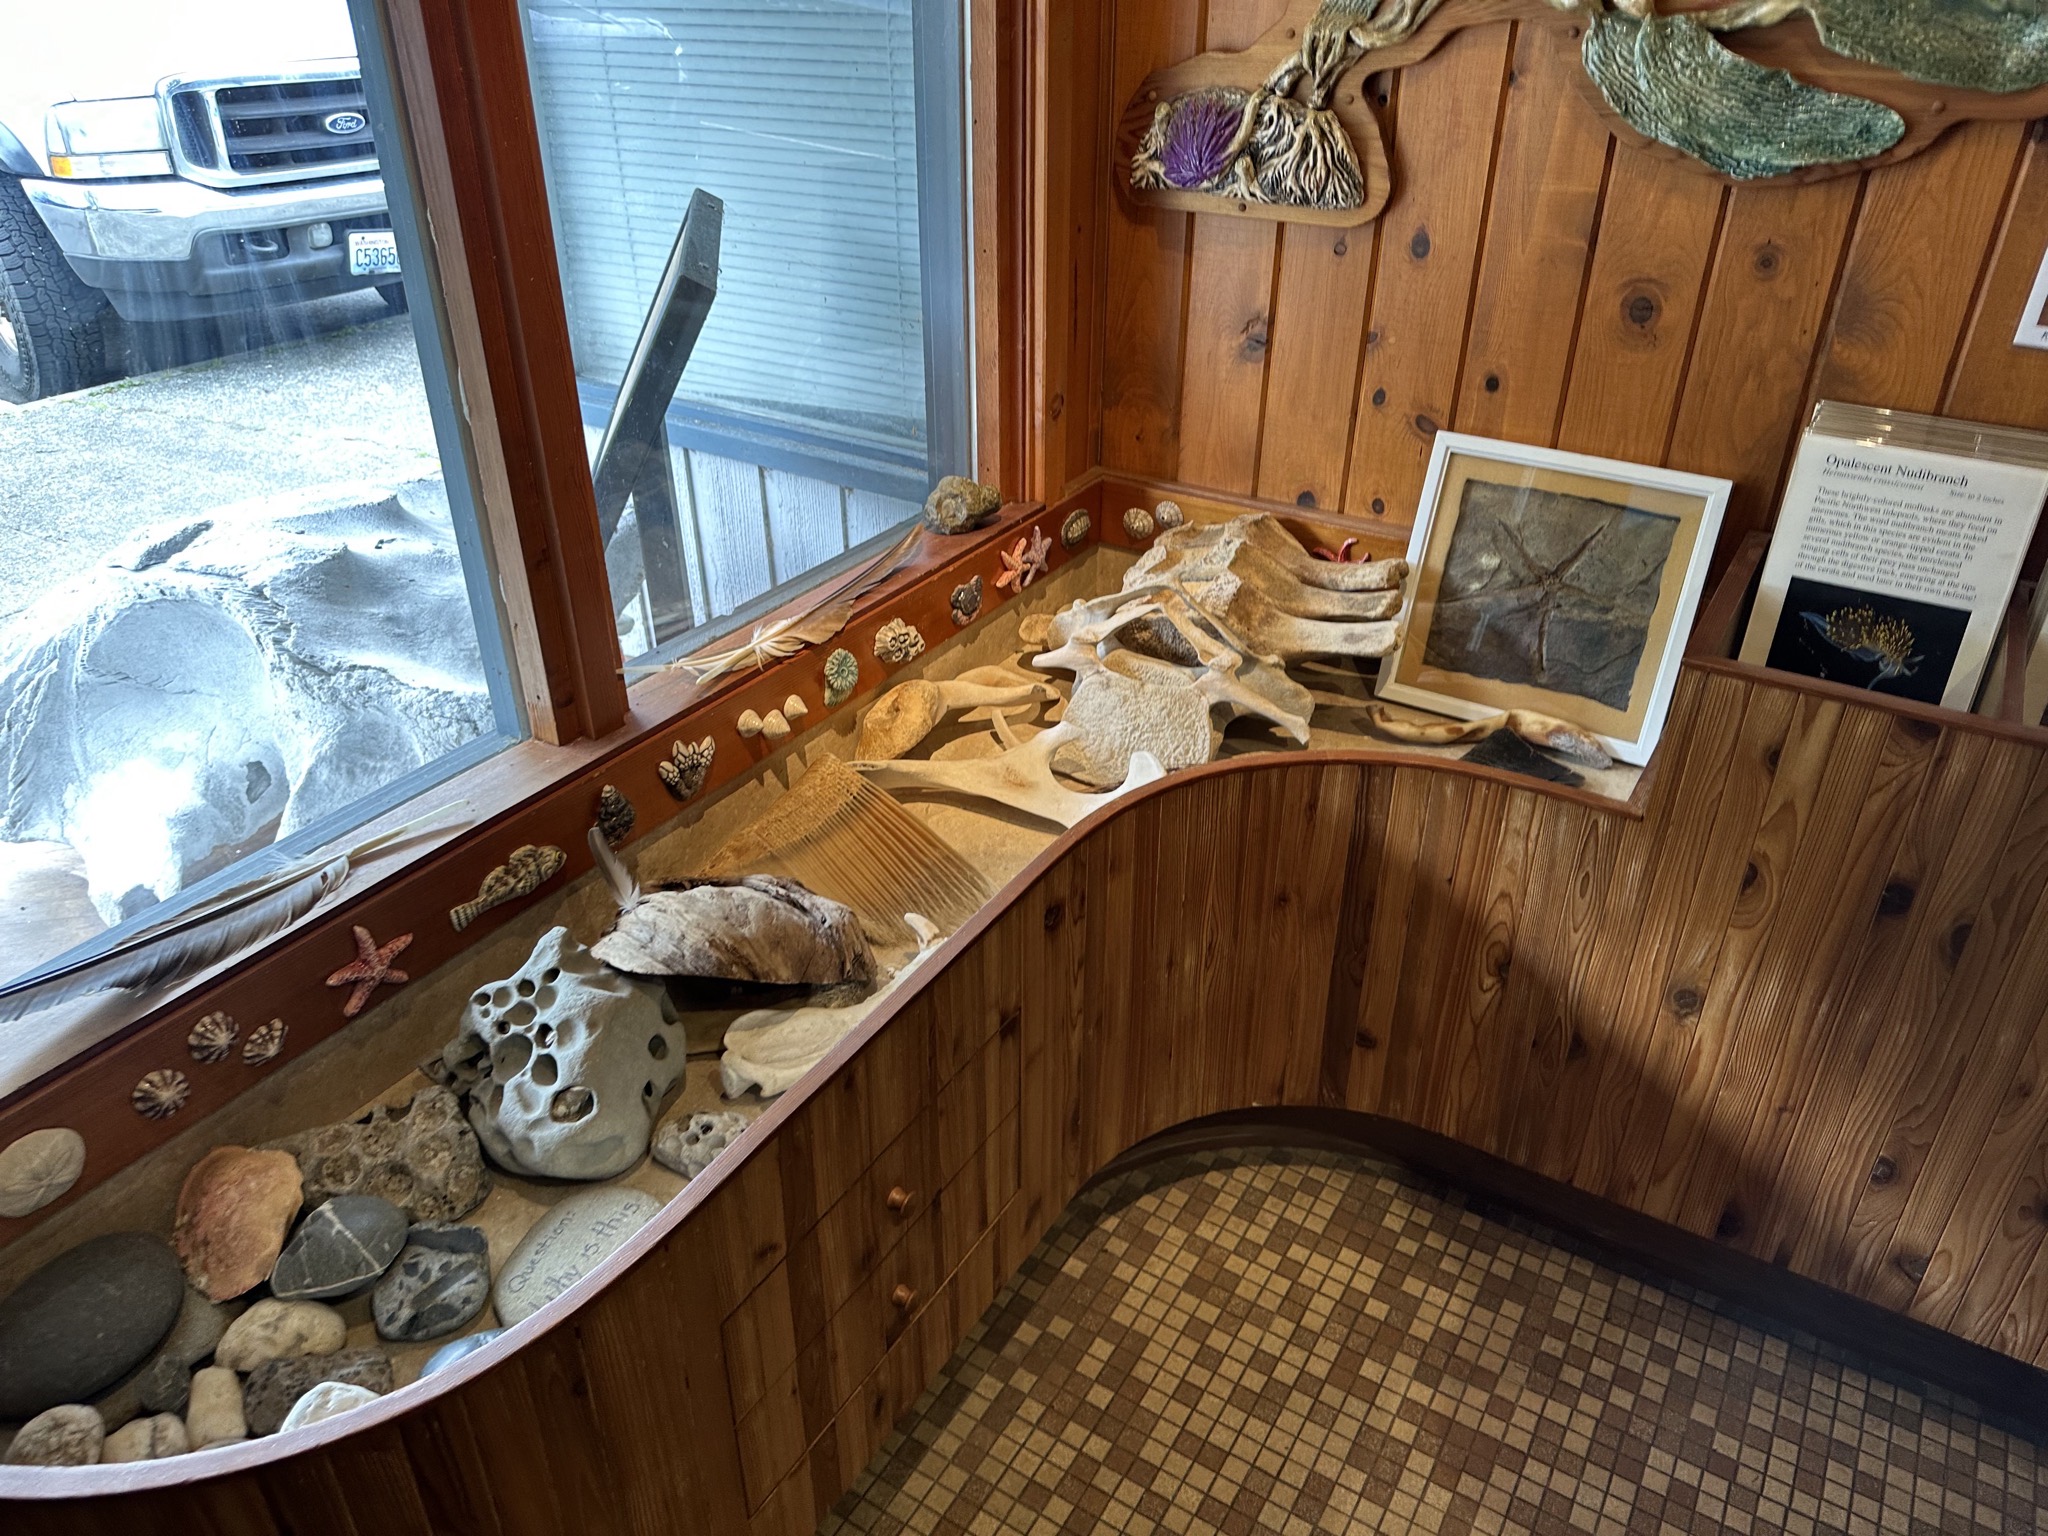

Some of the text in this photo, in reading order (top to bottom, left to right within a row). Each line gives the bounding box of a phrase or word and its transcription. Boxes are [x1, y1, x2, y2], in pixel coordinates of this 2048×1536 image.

[336, 117, 357, 130] Ford
[1827, 456, 1967, 486] Opalescent Nudibranch
[1815, 496, 1840, 506] Pacific
[1842, 500, 1880, 514] Northwest
[1923, 516, 1946, 525] where
[1948, 520, 1965, 529] they
[1968, 523, 1985, 532] feed
[1819, 488, 1839, 496] These
[1904, 503, 1939, 513] mollusks
[1956, 511, 1992, 523] abundant
[1983, 496, 2004, 504] inches
[1803, 535, 1829, 544] several
[1831, 540, 1872, 553] nudibranch
[1806, 526, 1842, 537] numerous
[1844, 532, 1868, 541] yellow
[1830, 520, 1851, 528] which
[1854, 523, 1861, 532] in
[1879, 529, 1906, 538] species
[1922, 536, 1950, 546] evident
[1963, 543, 1975, 552] the
[1870, 517, 1889, 525] word
[1891, 521, 1934, 533] nudibranch
[1936, 529, 1960, 538] means
[1963, 534, 1988, 542] naked
[1798, 552, 1825, 563] through
[1841, 560, 1875, 572] digestive
[1900, 573, 1936, 585] emerging
[1801, 544, 1830, 555] stinging
[1861, 554, 1877, 562] their
[1879, 559, 1896, 567] prey
[1917, 566, 1960, 578] unchanged
[1818, 566, 1839, 575] cerata
[1876, 576, 1892, 585] later
[1905, 582, 1921, 590] their
[581, 1242, 601, 1261] is
[591, 1202, 640, 1238] this
[508, 1211, 576, 1294] Question:
